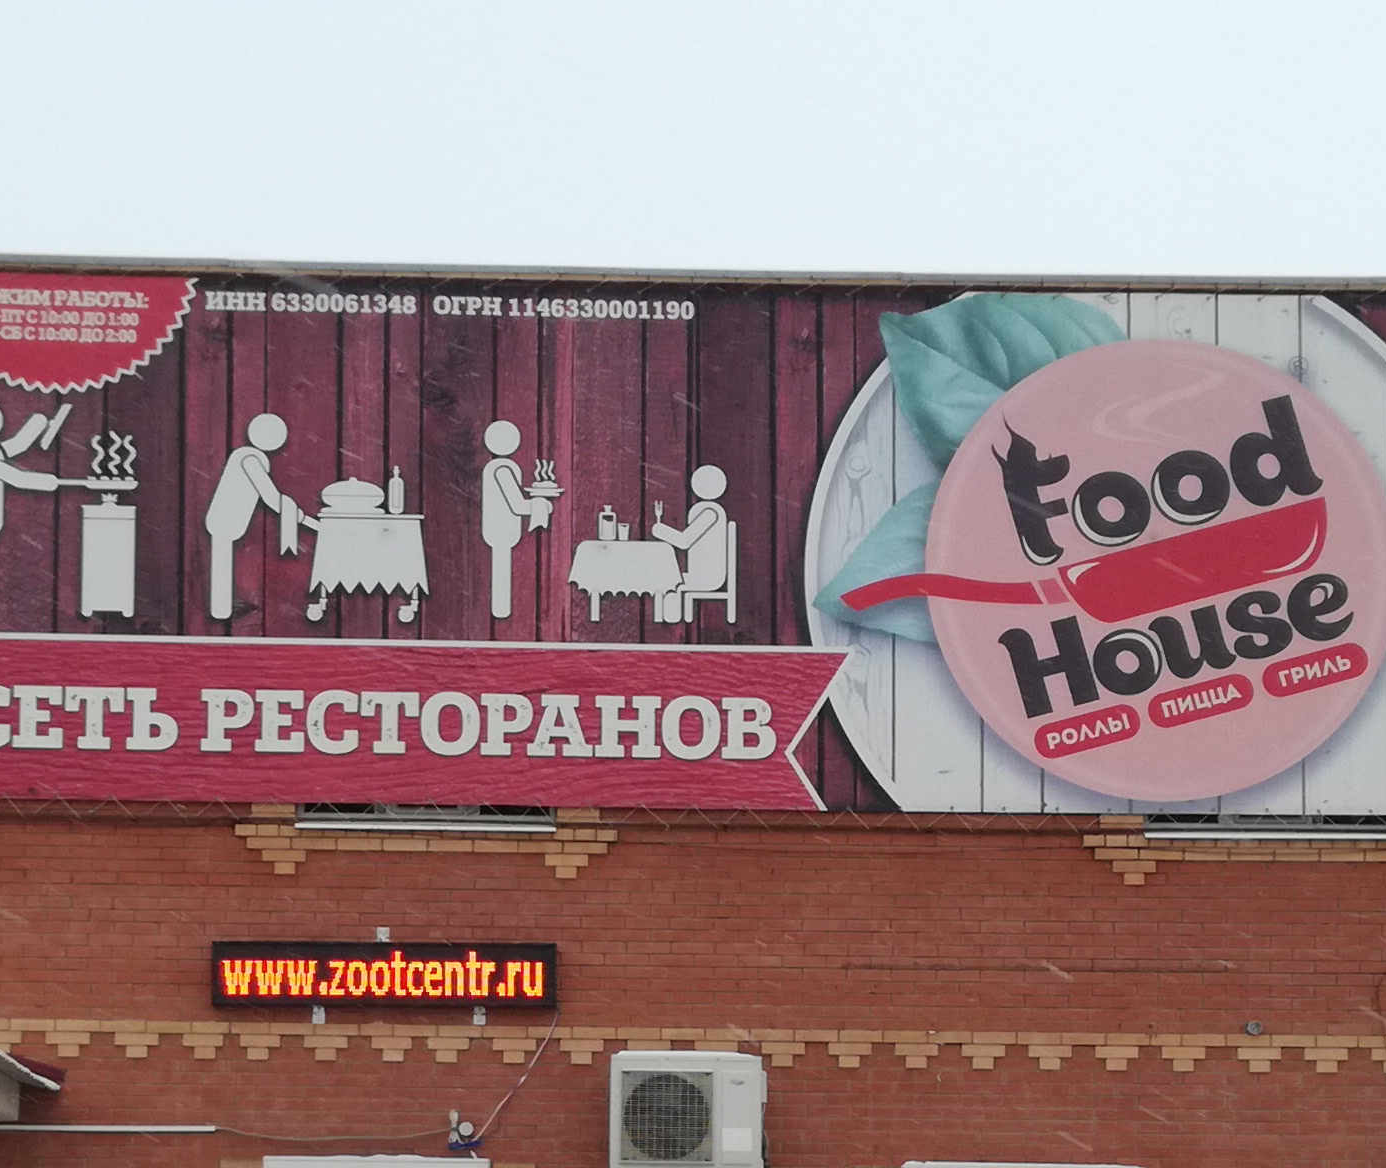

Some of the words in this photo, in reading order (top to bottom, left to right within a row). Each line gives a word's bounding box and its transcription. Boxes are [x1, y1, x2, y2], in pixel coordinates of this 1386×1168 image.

[54, 290, 149, 308] РАБОТЫ:
[205, 291, 266, 312] ИНН
[270, 292, 417, 314] 6330061348
[433, 295, 502, 316] ОГРН
[509, 297, 695, 320] 1146330001190
[38, 327, 78, 342] 10:00
[79, 328, 104, 344] ДО
[106, 328, 137, 343] 2:00
[40, 310, 79, 325] 10:00
[81, 311, 106, 327] ДО
[108, 312, 139, 327] 1:00
[999, 573, 1355, 720] House
[1046, 712, 1131, 750] РОЛЛЫ
[1161, 683, 1243, 718] ПИЦЦА
[1278, 655, 1352, 687] ГРИЛЬ
[200, 688, 778, 761] РЕСТОРАНОВ
[221, 950, 544, 997] www.zootcentr.ru
